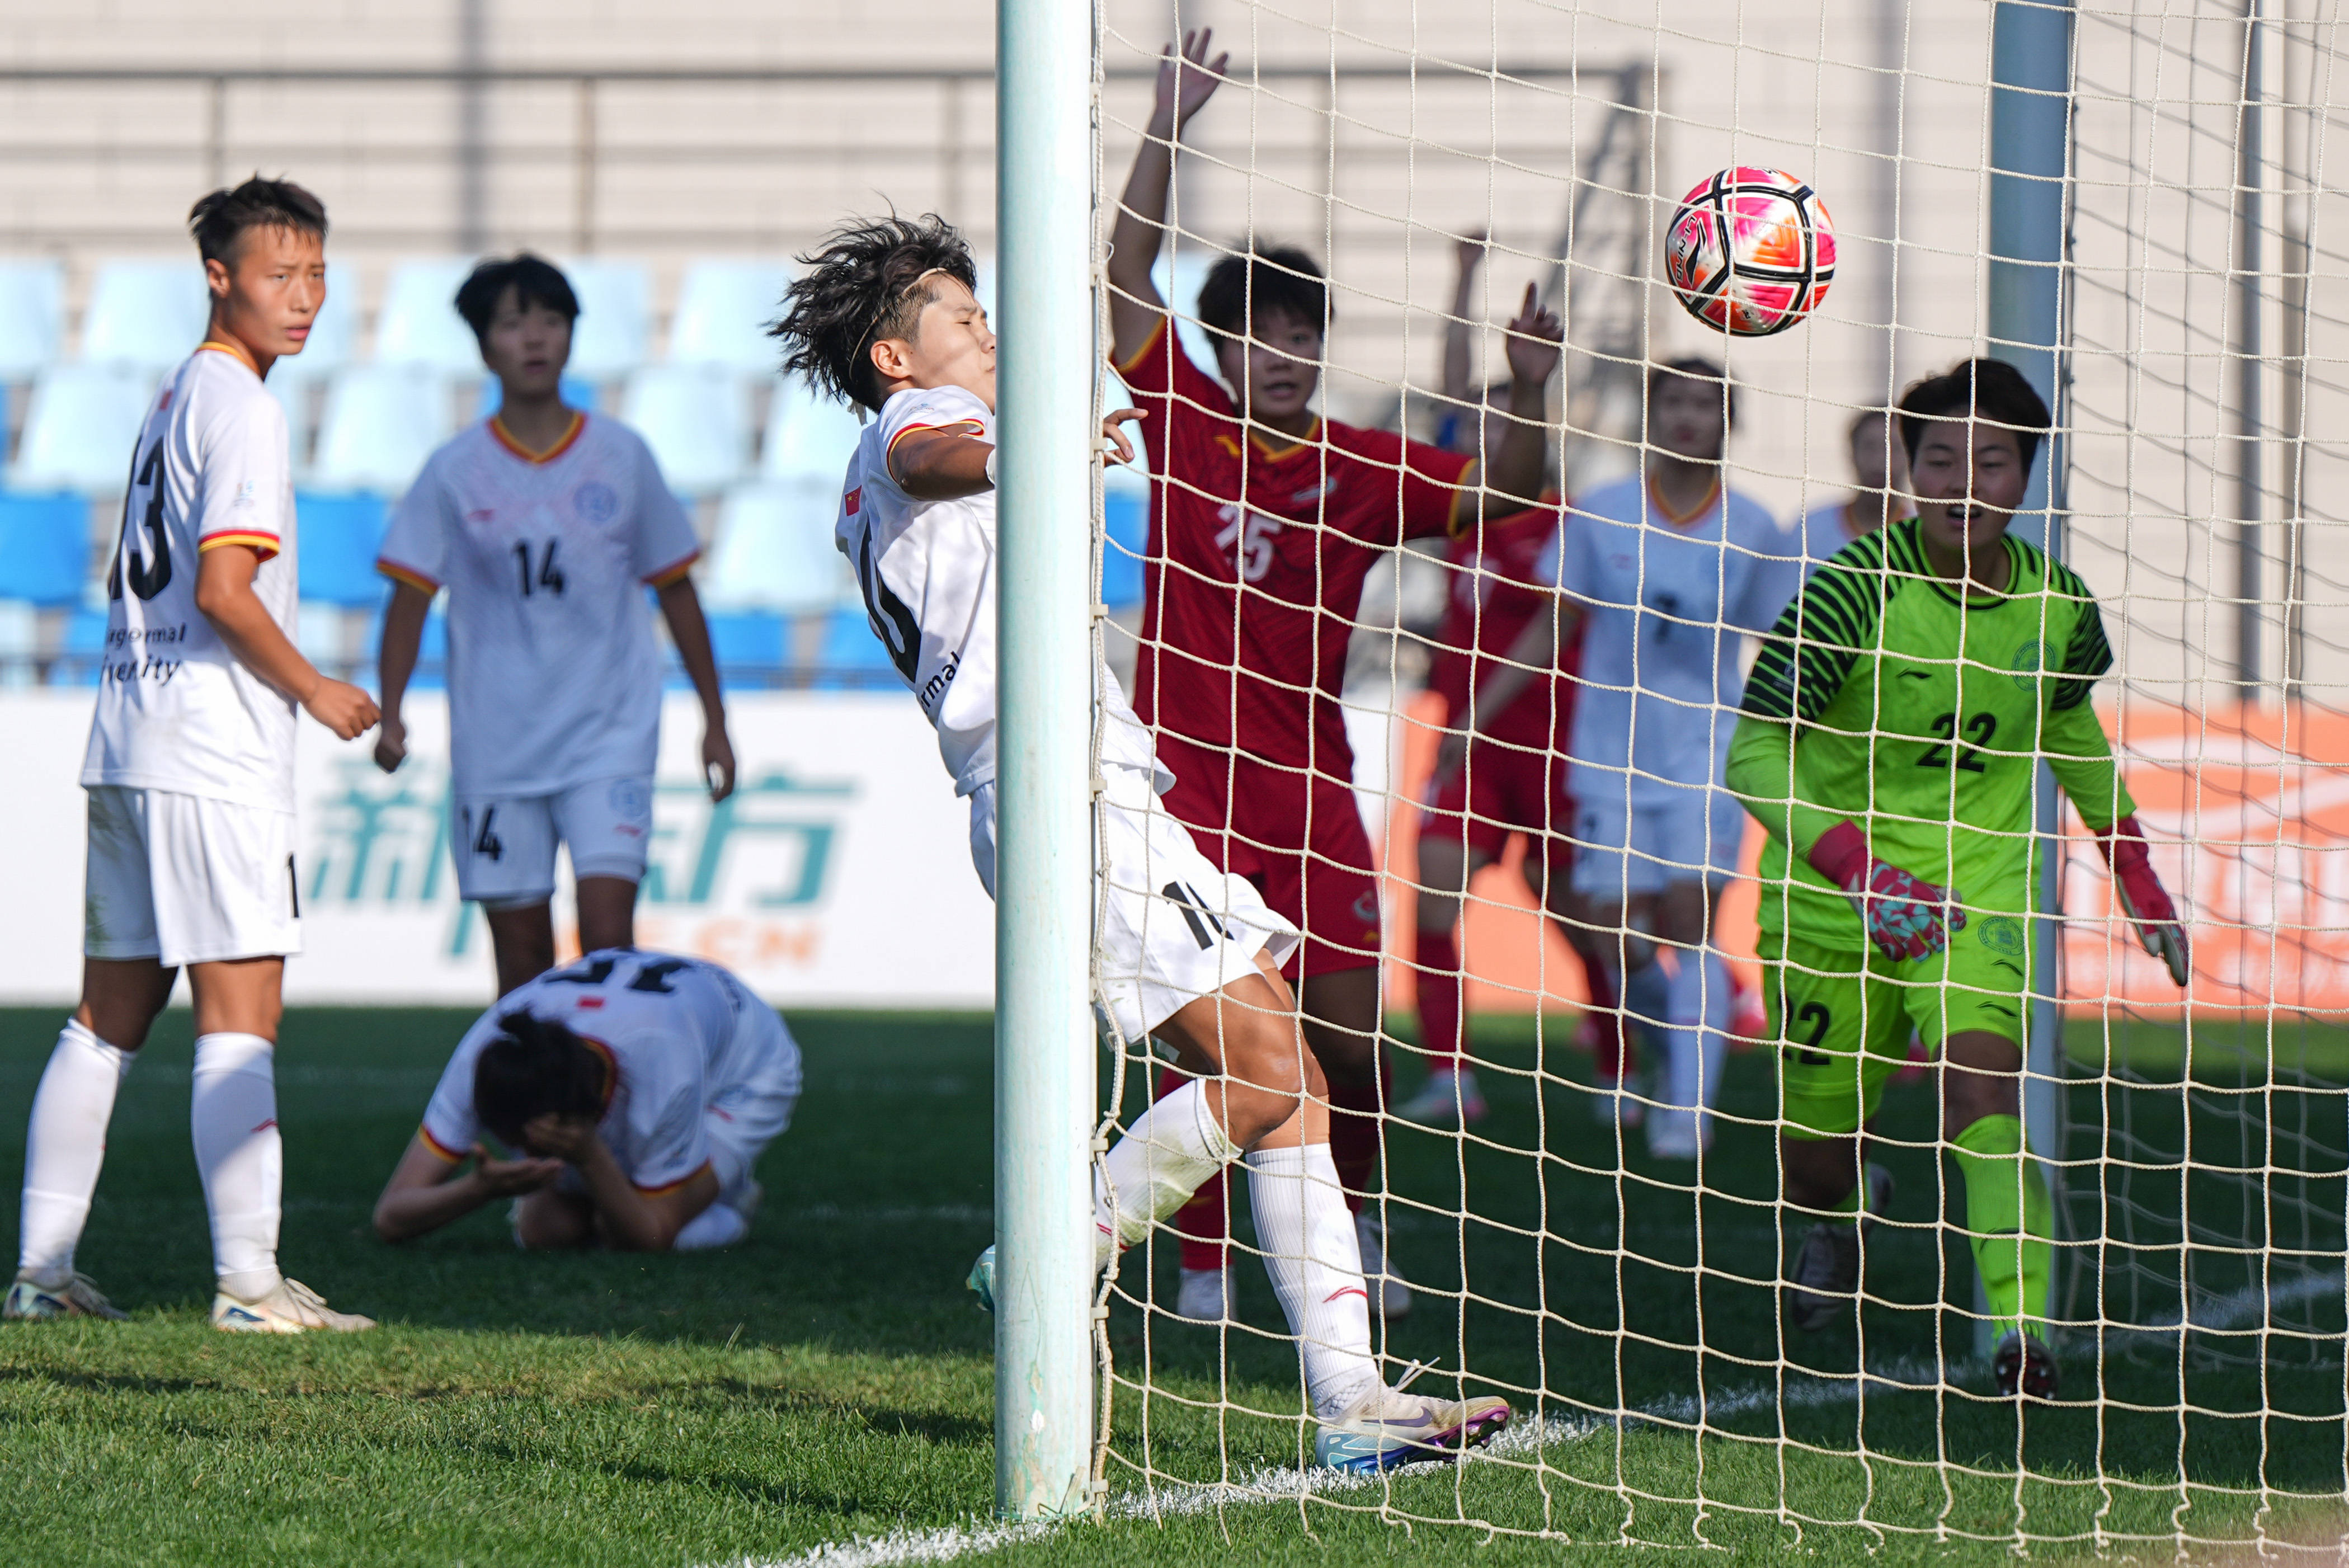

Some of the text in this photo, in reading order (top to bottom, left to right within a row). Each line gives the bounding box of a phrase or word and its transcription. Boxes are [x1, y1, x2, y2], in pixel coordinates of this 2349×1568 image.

[514, 538, 566, 597] 14
[1653, 591, 1679, 644] 7
[920, 651, 961, 715] rmal
[1916, 712, 1997, 773] 22
[462, 804, 503, 863] 14
